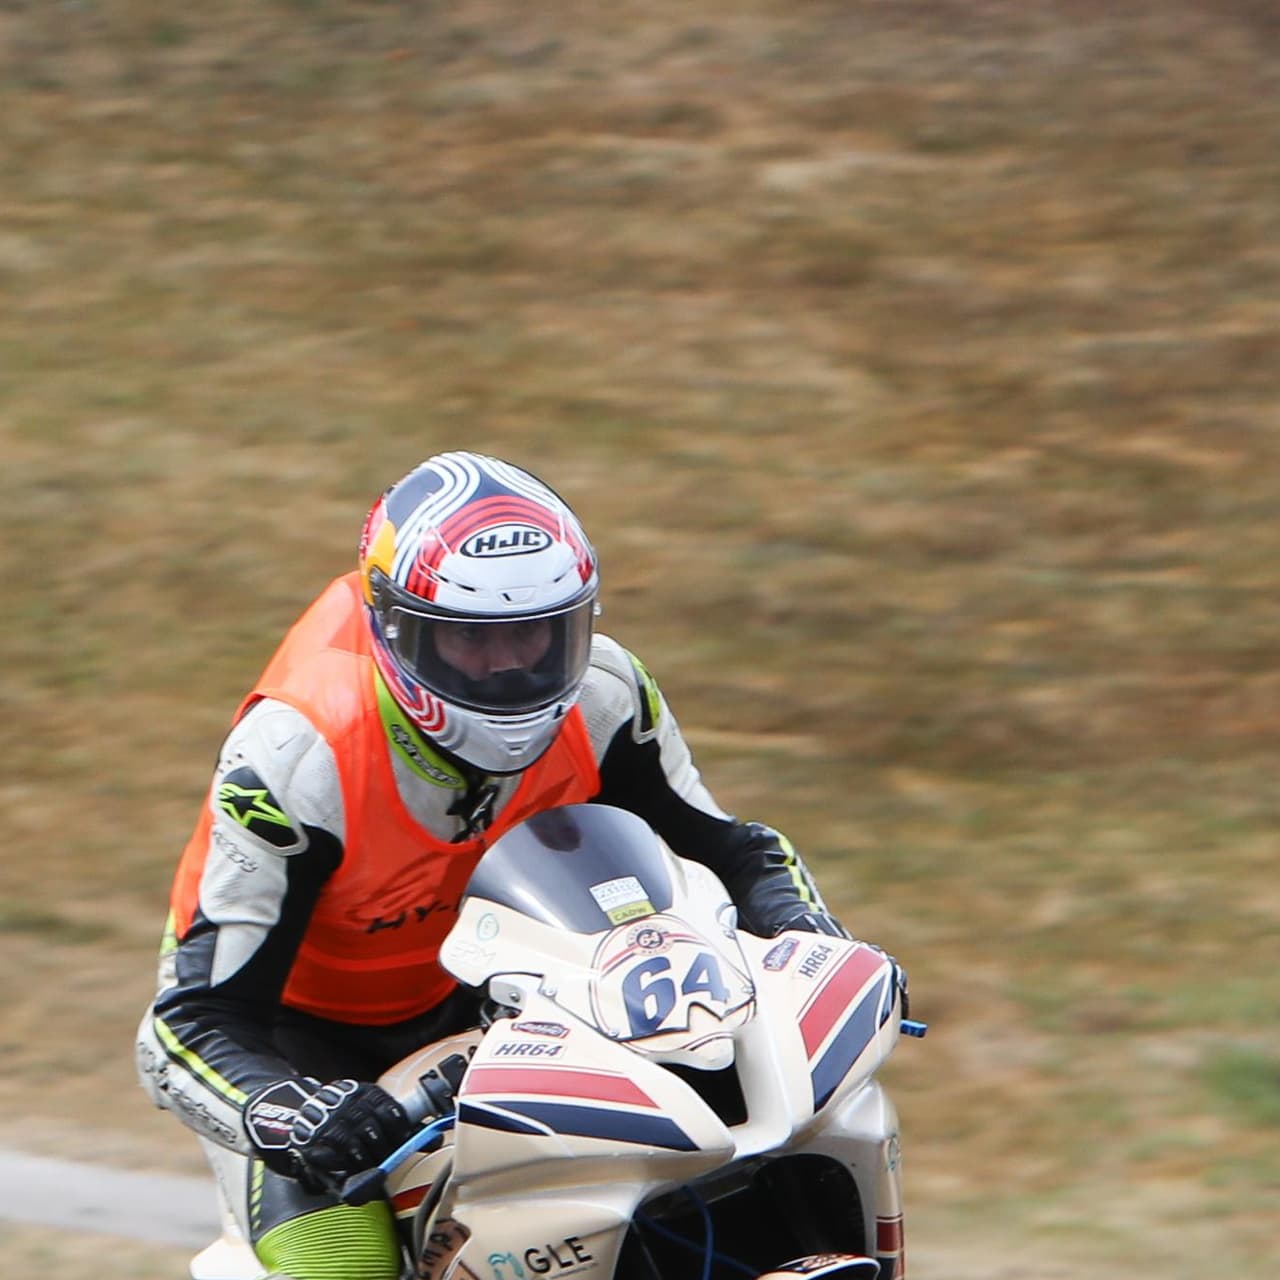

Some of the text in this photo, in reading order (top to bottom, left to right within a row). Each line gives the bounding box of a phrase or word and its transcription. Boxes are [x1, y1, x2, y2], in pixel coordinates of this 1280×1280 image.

[474, 531, 541, 554] HJC
[798, 944, 833, 978] HR64
[622, 956, 731, 1039] 64
[494, 1043, 563, 1057] HR64
[524, 1237, 593, 1274] GLE
